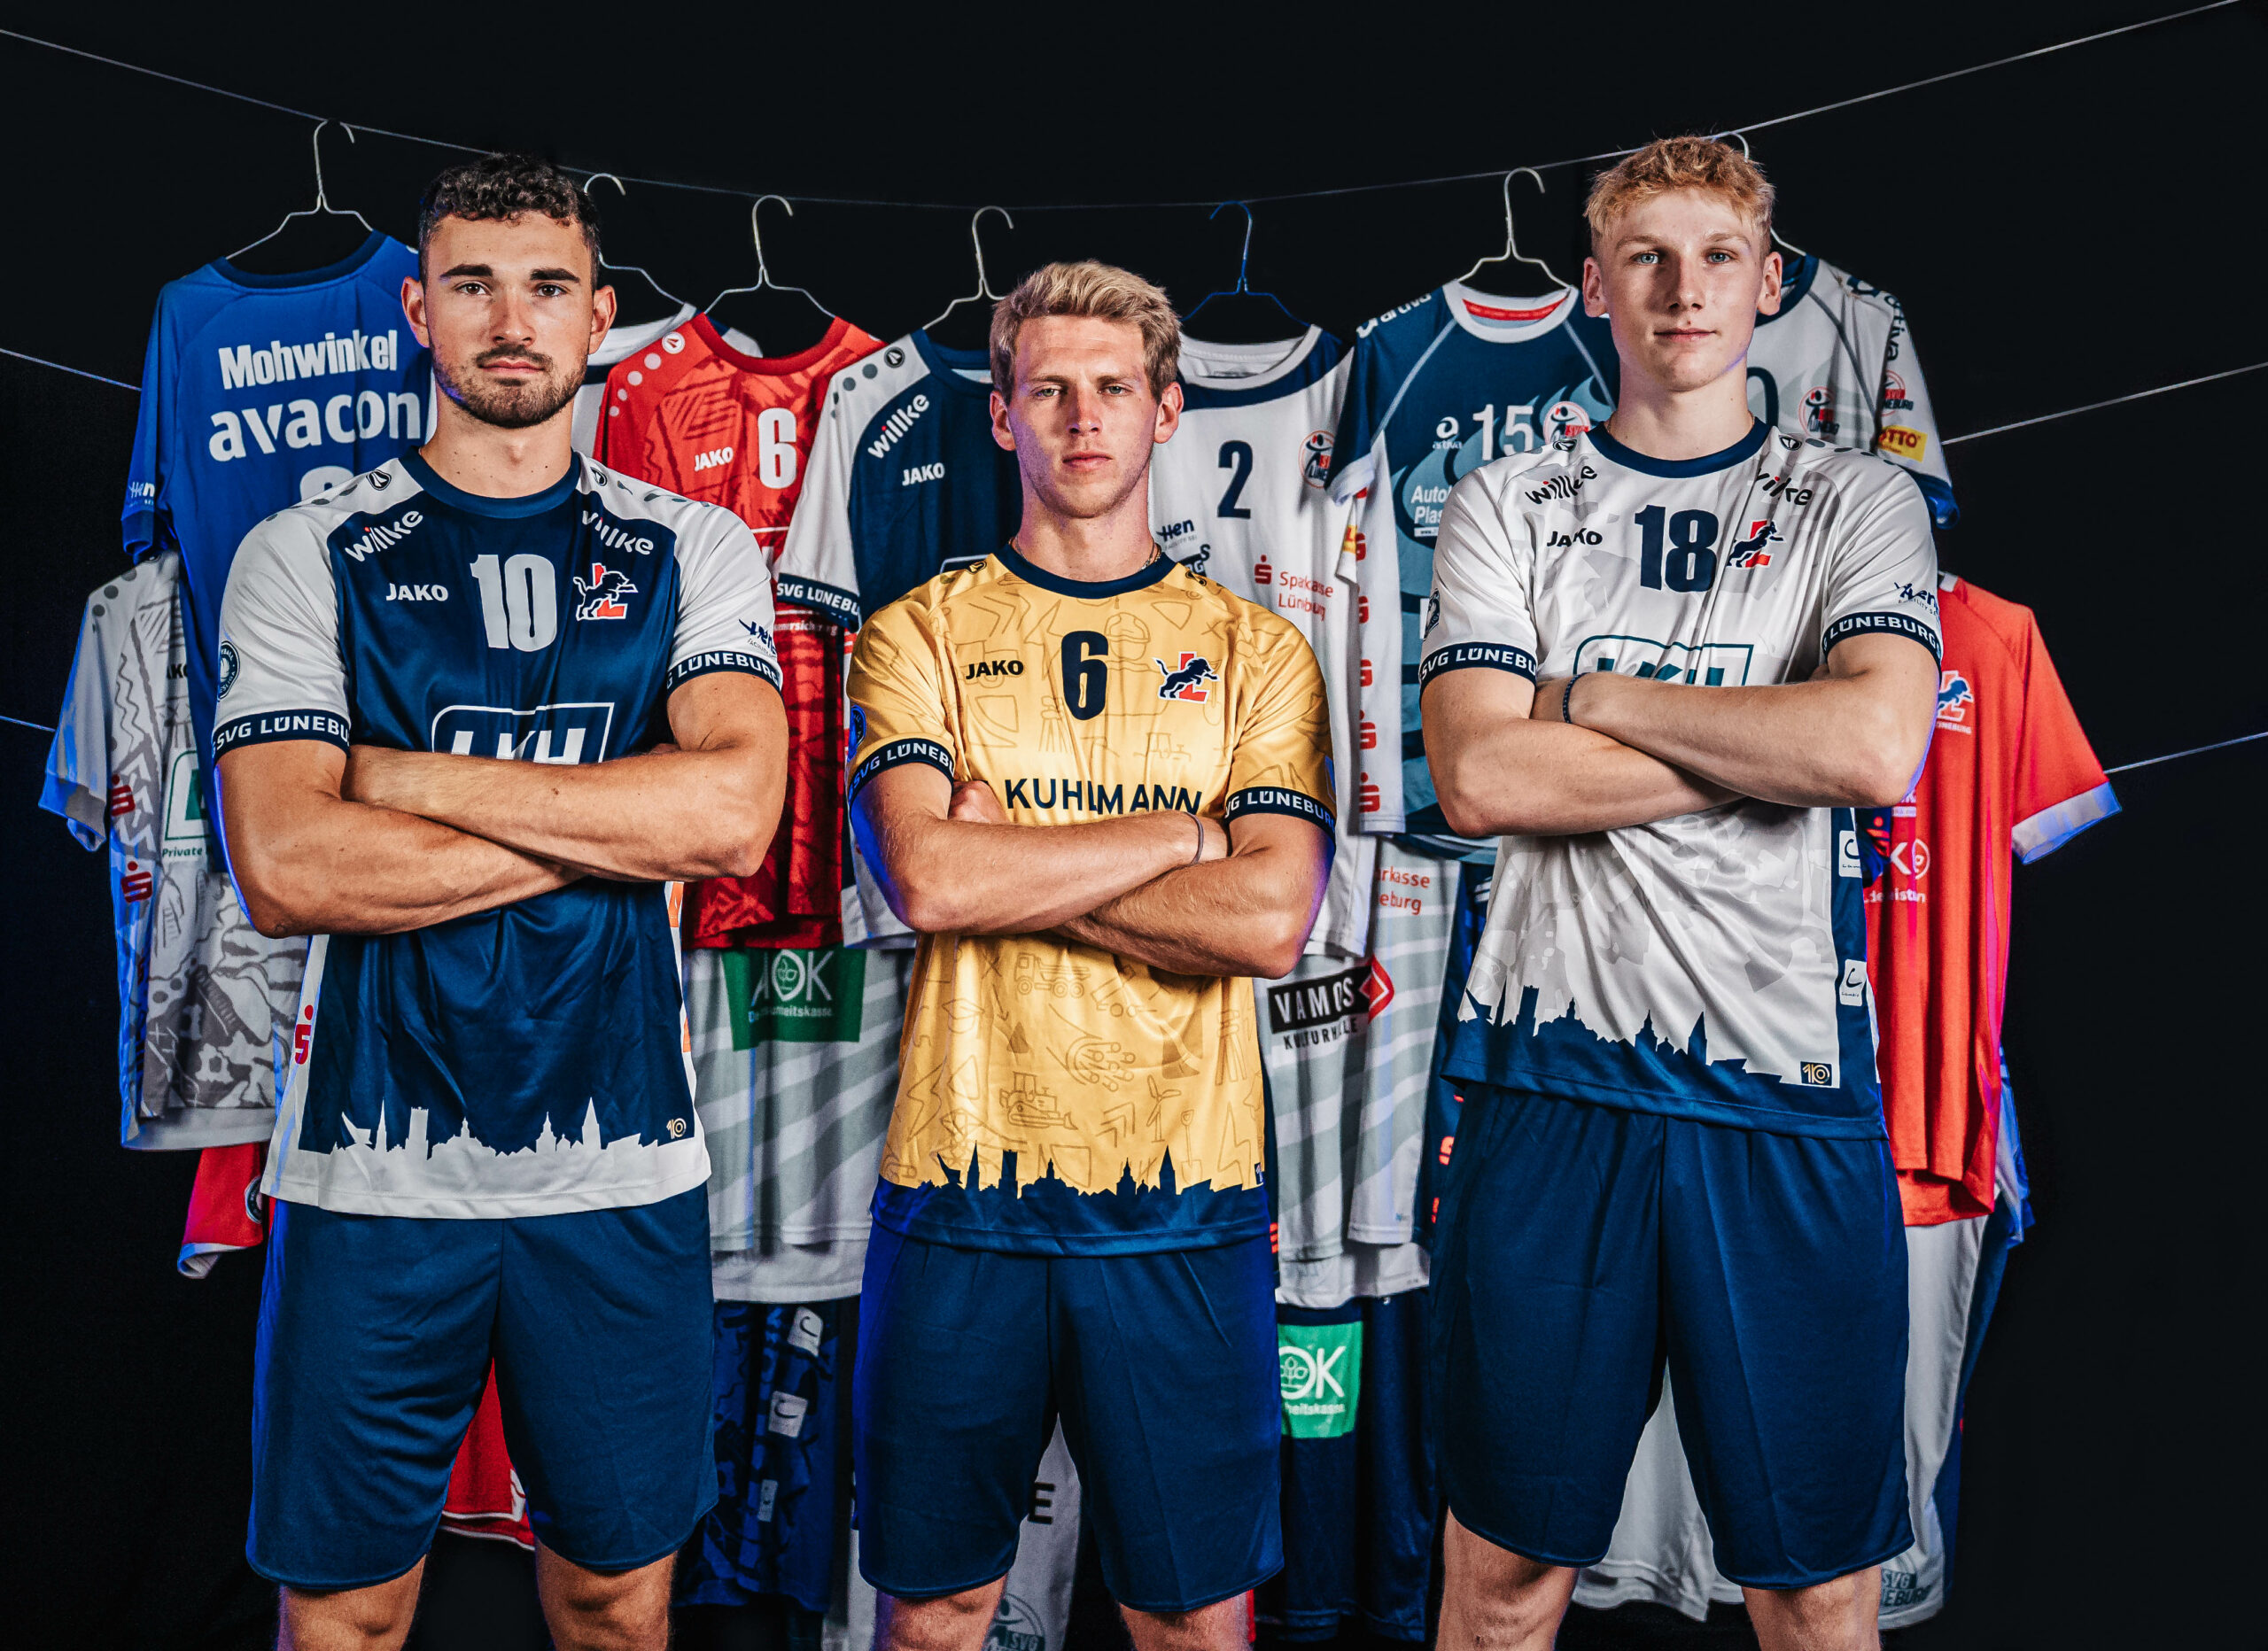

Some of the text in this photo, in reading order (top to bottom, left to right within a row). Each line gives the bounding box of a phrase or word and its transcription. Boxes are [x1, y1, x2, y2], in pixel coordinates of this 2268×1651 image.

[218, 329, 398, 390] Mohwinkel
[209, 390, 421, 462] avacon
[867, 394, 930, 459] willke
[1472, 404, 1534, 461] 15
[694, 446, 734, 472] JAKO
[757, 407, 797, 489] 6
[901, 462, 945, 487] JAKO
[1217, 440, 1254, 519] 2
[1410, 484, 1453, 504] Auto
[1546, 527, 1604, 547] JAKO
[1635, 504, 1717, 593] 18
[385, 582, 449, 602] JAKO
[470, 554, 557, 653] 10
[776, 582, 804, 599] SVG
[966, 659, 1024, 680] JAKO
[1061, 630, 1109, 720] 6
[1420, 651, 1449, 681] SVG
[216, 715, 350, 751] SVG LÜNEBU
[161, 847, 203, 858] Private
[1274, 977, 1355, 1025] VAMOS
[665, 1117, 687, 1141] 10
